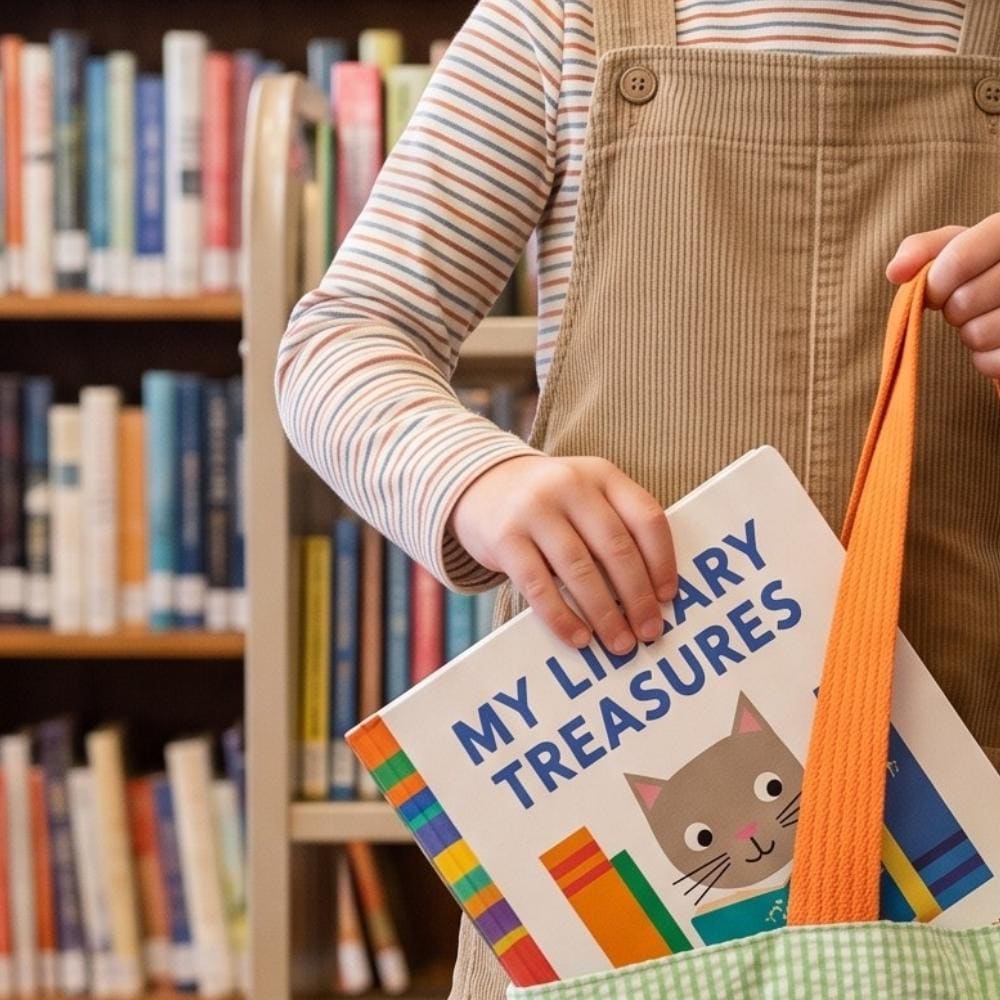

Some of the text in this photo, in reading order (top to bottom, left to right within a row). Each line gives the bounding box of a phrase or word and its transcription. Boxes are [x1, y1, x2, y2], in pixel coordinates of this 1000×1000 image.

[451, 517, 767, 767] MY LIARY
[491, 578, 803, 811] TREASURES
